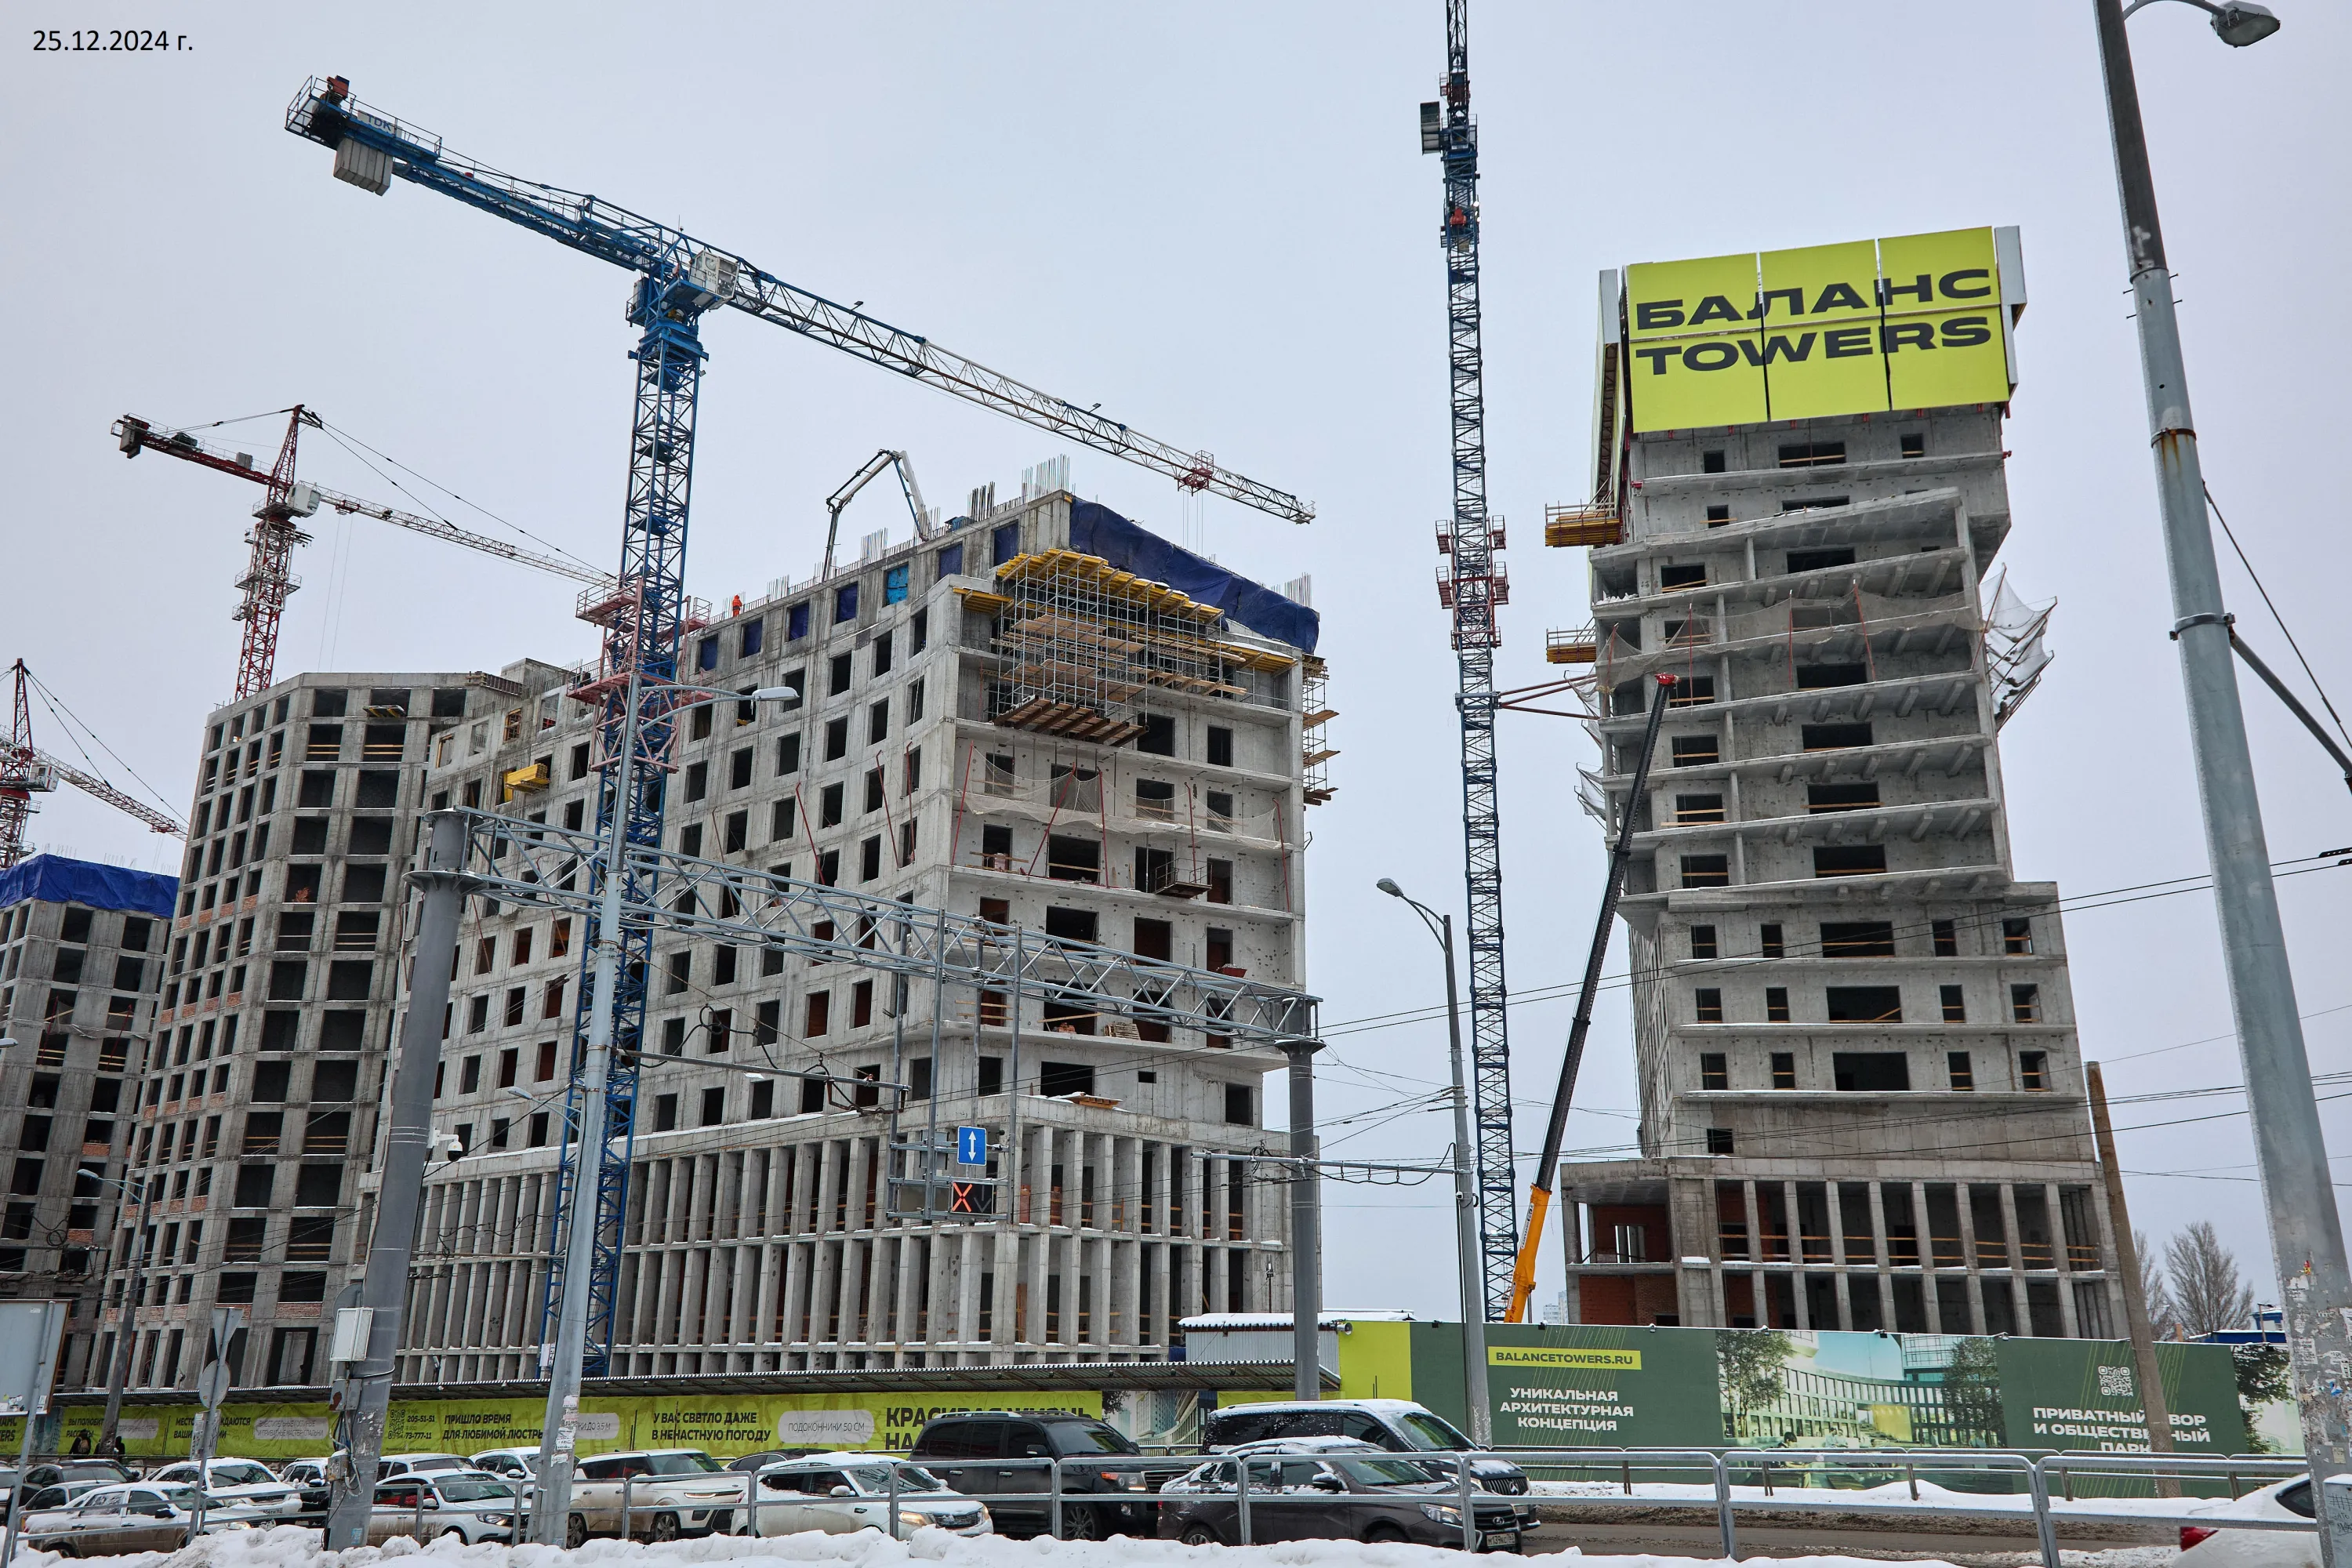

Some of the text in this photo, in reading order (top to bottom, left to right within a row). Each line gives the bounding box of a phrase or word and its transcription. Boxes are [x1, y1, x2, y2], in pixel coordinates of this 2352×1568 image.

[368, 114, 393, 132] TDK
[1636, 269, 1991, 331] БАЛАНС
[1636, 317, 1991, 375] TOWERS
[1496, 1352, 1633, 1365] BALANCETOWERS.RU
[1510, 1387, 1618, 1402] УНИКАЛЬНАЯ
[1500, 1402, 1635, 1417] АРХИТЕКТУРНАЯ
[445, 1414, 511, 1424] ПРИШЛО ВРЕМЯ
[654, 1413, 757, 1425] У ВАС СВЕТЛО ДАЖЕ
[1517, 1417, 1617, 1432] КОНЦЕПЦИЯ
[2168, 1414, 2206, 1426] ВОР
[788, 1422, 865, 1432] ПОДОКОННИКИ 50 СМ
[2034, 1423, 2048, 1435] И
[443, 1429, 460, 1441] ДЛЯ
[462, 1427, 506, 1439] ЛЮБИМОЙ
[652, 1429, 771, 1442] В НЕНАСТНУЮ ПОГОДУ
